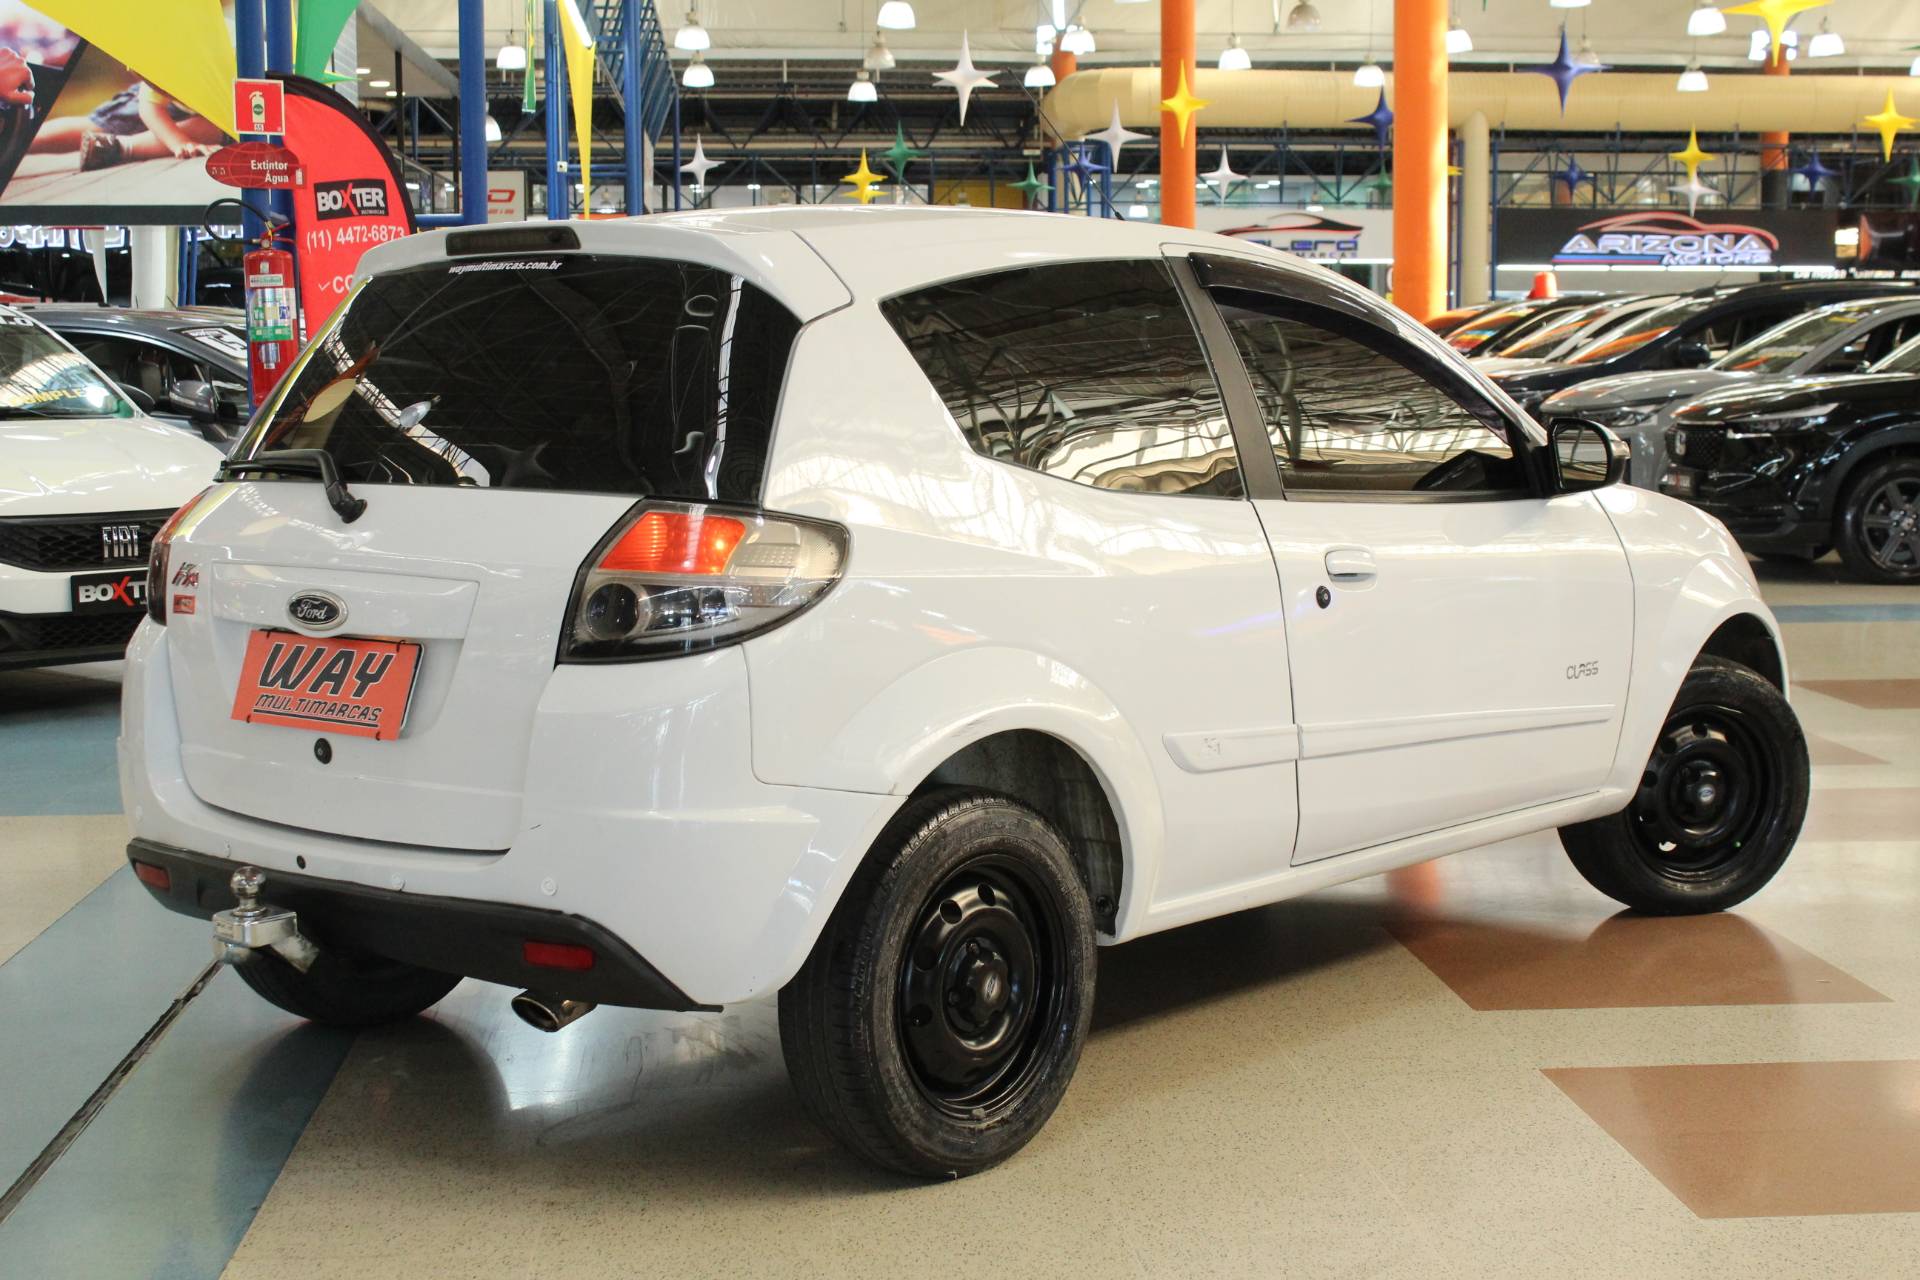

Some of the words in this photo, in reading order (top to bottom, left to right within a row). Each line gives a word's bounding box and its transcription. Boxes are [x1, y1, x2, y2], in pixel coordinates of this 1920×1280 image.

[250, 159, 289, 171] Extintor
[264, 170, 289, 184] Água
[316, 183, 386, 216] BOXTER
[306, 230, 332, 253] (11)
[336, 225, 405, 244] 4472-6873
[1560, 233, 1771, 253] ARIZONA
[448, 260, 563, 275] waymultimarcas.com.br
[1661, 251, 1772, 266] MOTORS
[102, 525, 140, 559] FIAT
[297, 599, 328, 620] Ford
[258, 641, 396, 699] WAY
[1567, 660, 1599, 680] CLASS
[255, 694, 384, 722] MULTIMARCAS
